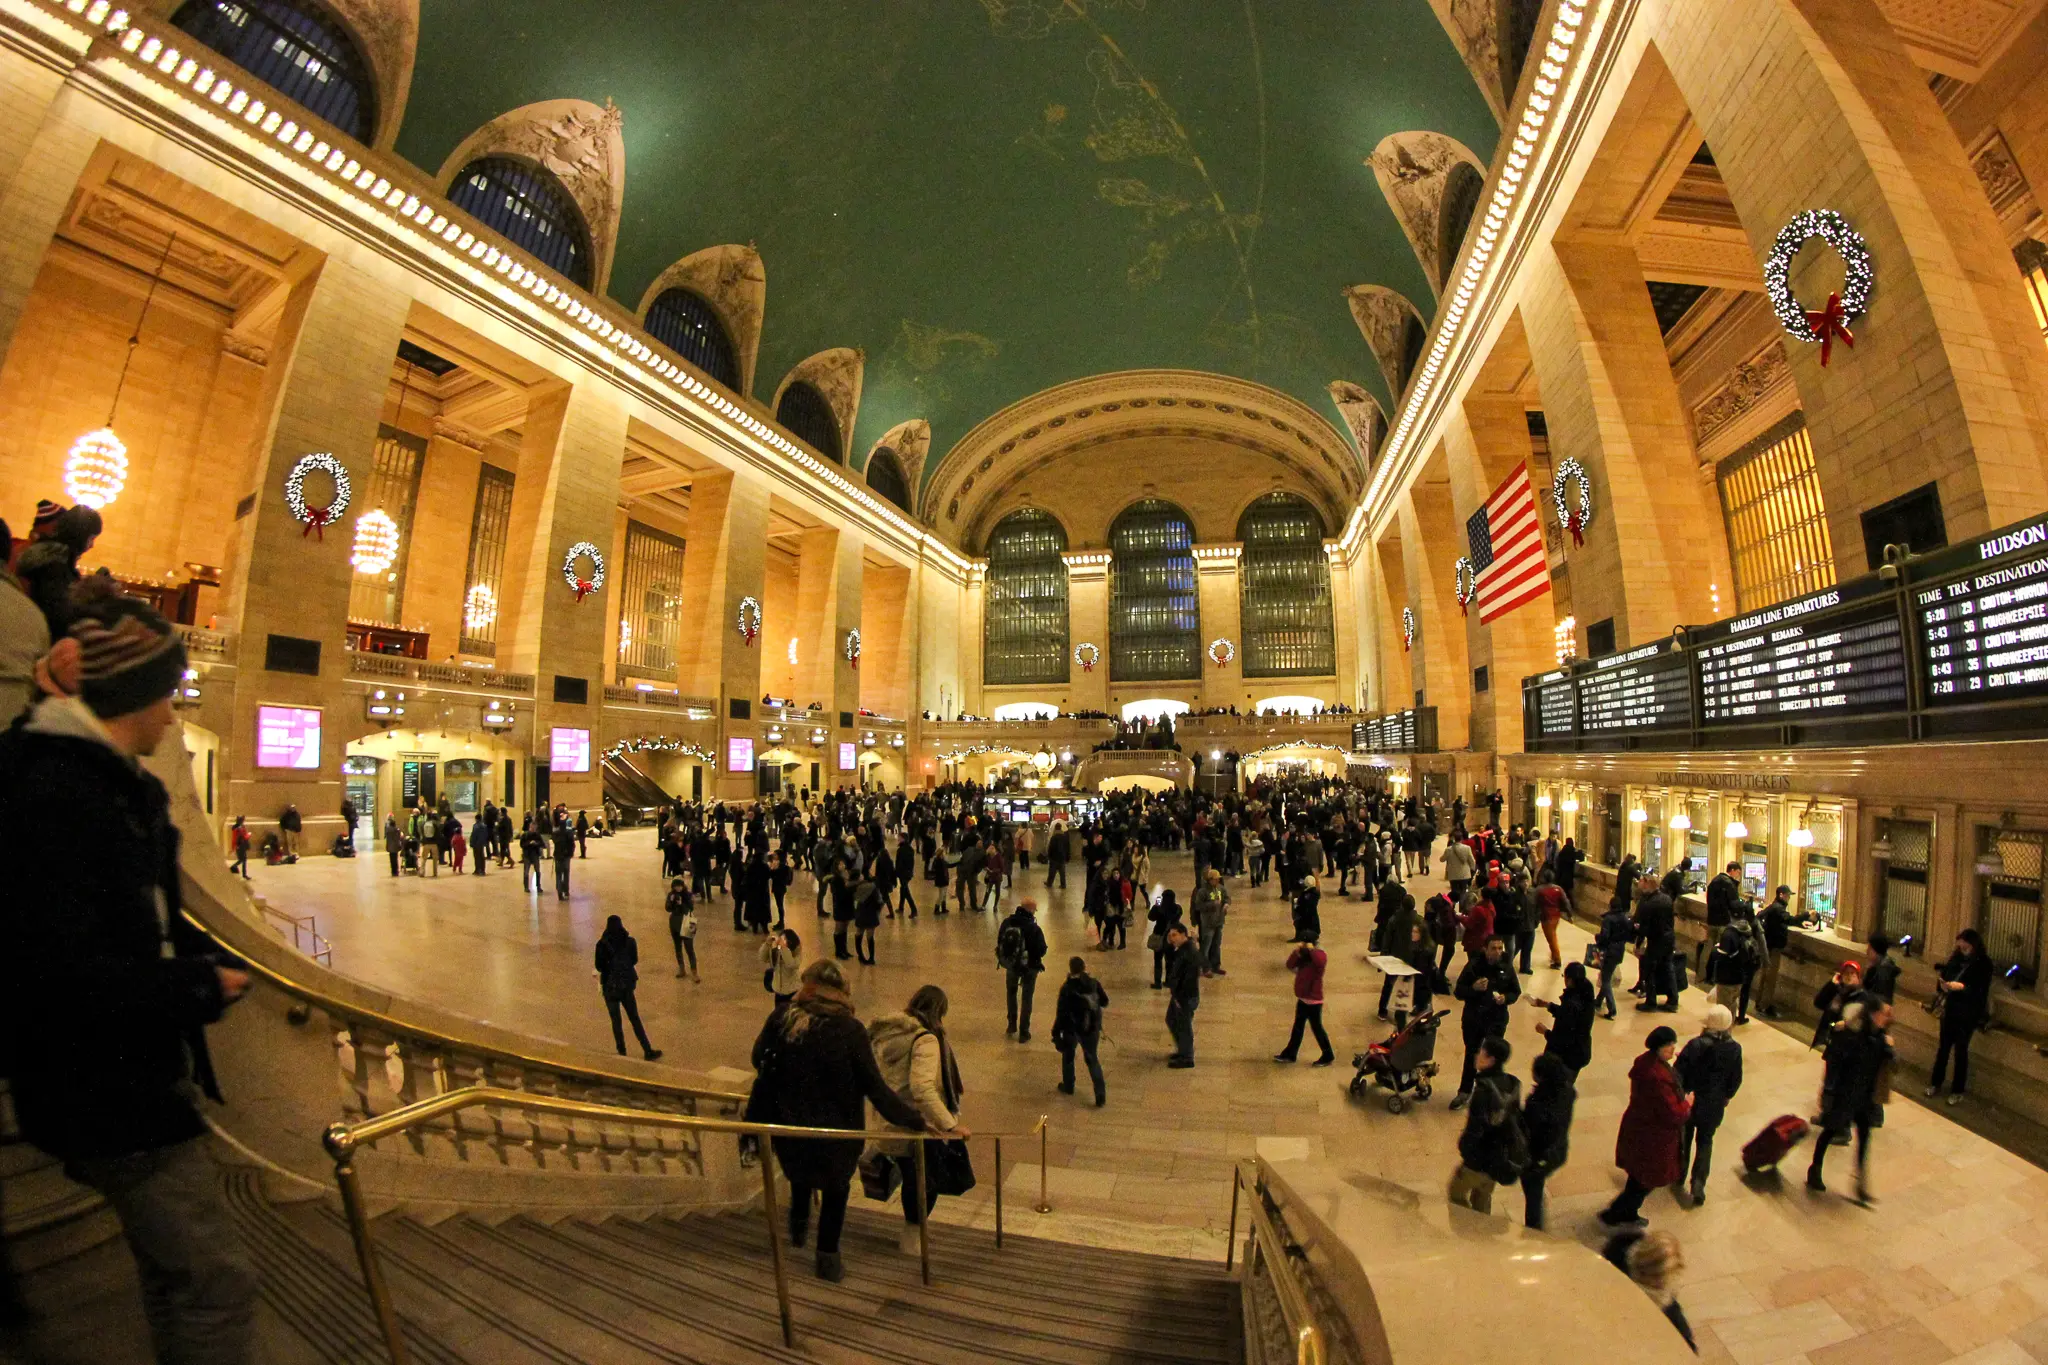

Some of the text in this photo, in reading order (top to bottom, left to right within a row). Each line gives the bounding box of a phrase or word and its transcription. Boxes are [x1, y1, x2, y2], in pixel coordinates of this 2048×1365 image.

[1980, 523, 2046, 559] HUDSON
[1918, 557, 2048, 604] TIME TRK DESTINATION
[1730, 591, 1839, 633] HARLEM LINE DEPARTURES
[1926, 608, 1946, 623] 5:20
[1961, 601, 1973, 614] 29
[1928, 604, 2046, 640] 5:43 36 POUGHKEEPSIE
[1698, 626, 1803, 659] TIME TRK DESTINATION REMARKS
[1776, 643, 1806, 656] CONNECTION
[1930, 644, 1950, 658] 6:20
[1966, 639, 1977, 652] 30
[1628, 645, 1658, 662] DEPARTURES
[1818, 650, 1833, 662] STOP
[1836, 662, 1850, 674] STOP
[1932, 662, 1952, 676] 6:43
[1968, 658, 1980, 670] 35
[1821, 681, 1835, 691] STOP
[1934, 681, 1953, 694] 7:20
[1970, 677, 1981, 689] 29
[1780, 699, 1810, 711] CONNECTION
[1745, 774, 1790, 790] TICKETS
